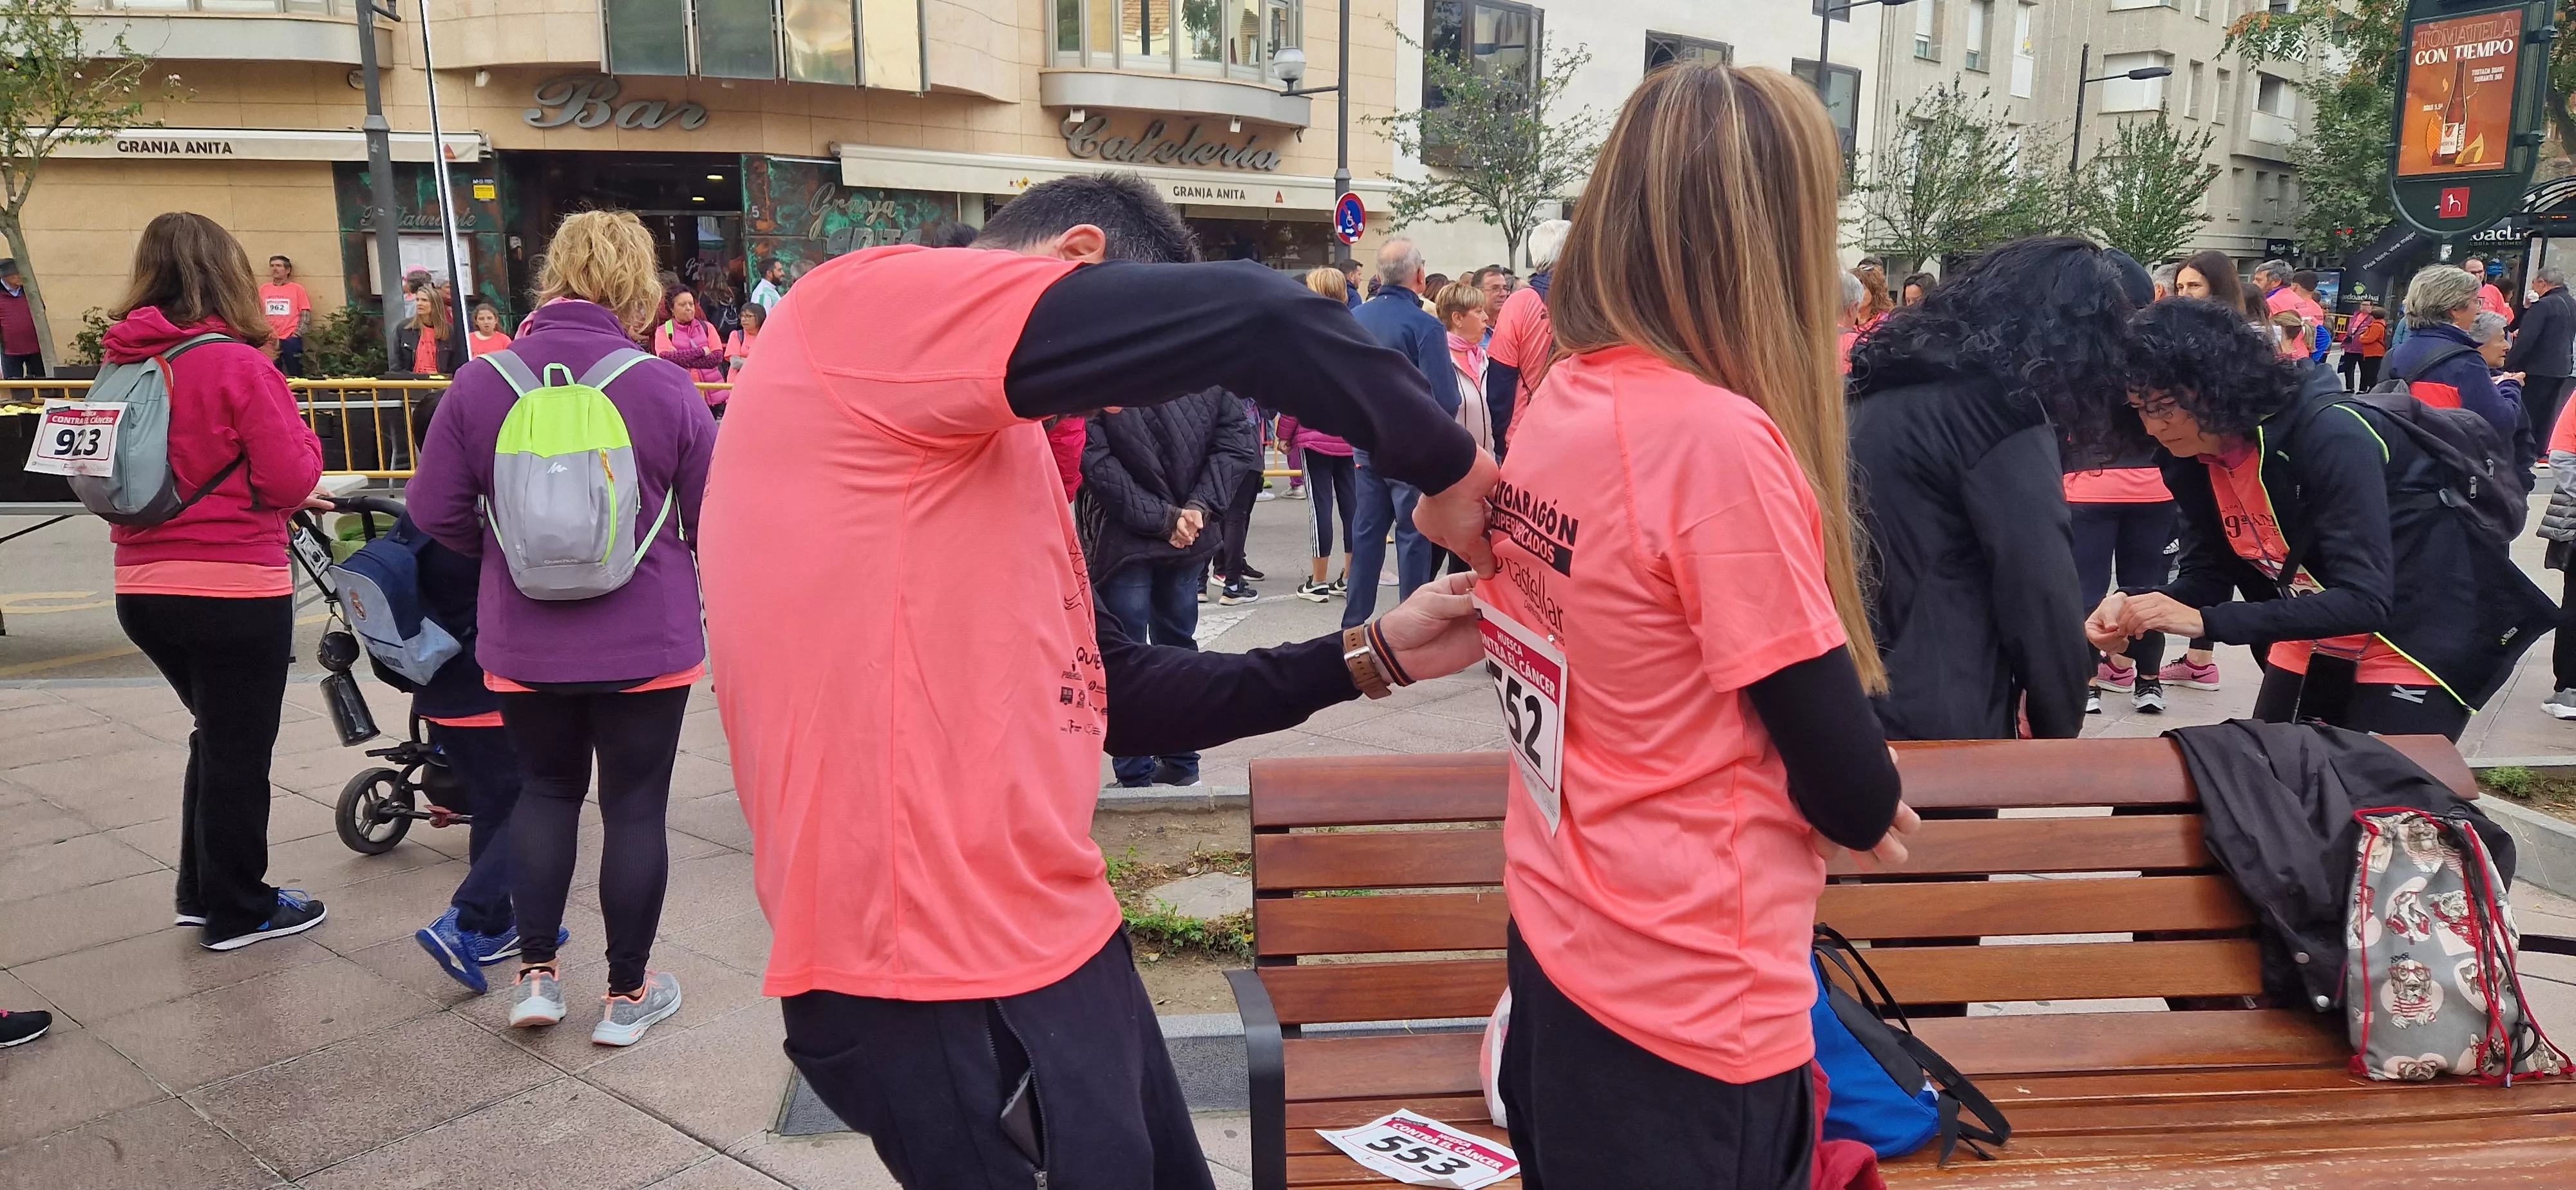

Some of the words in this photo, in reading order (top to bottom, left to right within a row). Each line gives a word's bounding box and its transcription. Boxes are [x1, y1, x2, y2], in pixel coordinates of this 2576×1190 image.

[2415, 47, 2448, 66] CON
[2454, 39, 2513, 60] TIEMPO
[522, 74, 708, 129] Bar
[117, 140, 180, 155] GRANJA
[185, 140, 232, 155] ANITA
[1173, 185, 1213, 200] GRANJA
[1217, 187, 1246, 200] ANITA
[751, 205, 760, 218] 5
[809, 182, 897, 241] Granja
[52, 415, 83, 424] CONTRA
[54, 428, 101, 456] 923
[1505, 557, 1564, 634] castellar
[1497, 630, 1524, 657] HUESCA
[1507, 650, 1519, 671] EL
[1519, 660, 1556, 700] CÁNCER
[1392, 1123, 1439, 1146] CONTRA
[1437, 1140, 1453, 1150] EL
[1454, 1146, 1505, 1169] CÁNCER
[1436, 1133, 1472, 1149] HUESCA
[1365, 1135, 1472, 1175] 553
